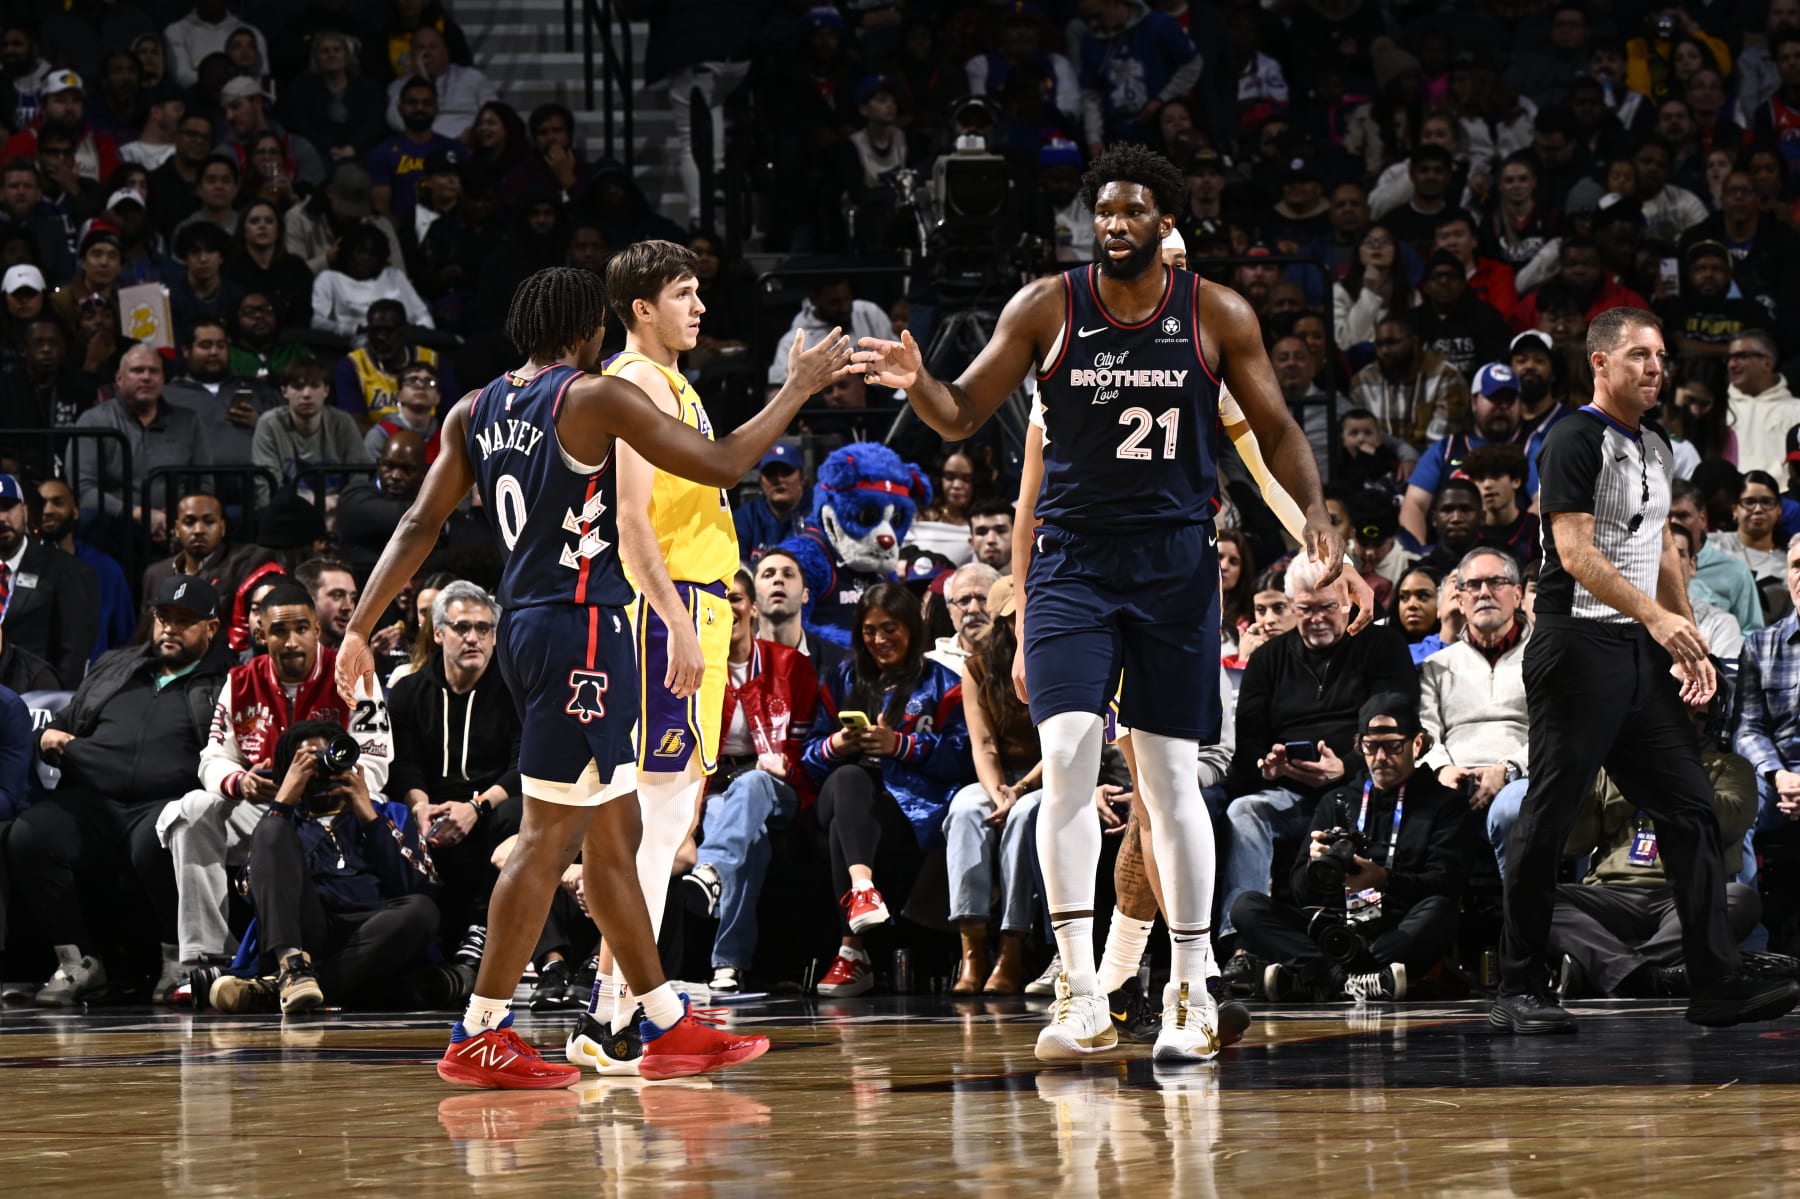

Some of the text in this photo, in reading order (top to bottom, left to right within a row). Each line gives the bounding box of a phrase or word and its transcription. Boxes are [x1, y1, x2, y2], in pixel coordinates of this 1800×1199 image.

[1094, 350, 1130, 370] City of
[1070, 369, 1189, 388] BROTHERLY
[1091, 386, 1120, 406] Love
[475, 419, 544, 461] MAXEY
[1116, 406, 1180, 460] 21
[495, 474, 528, 552] 0
